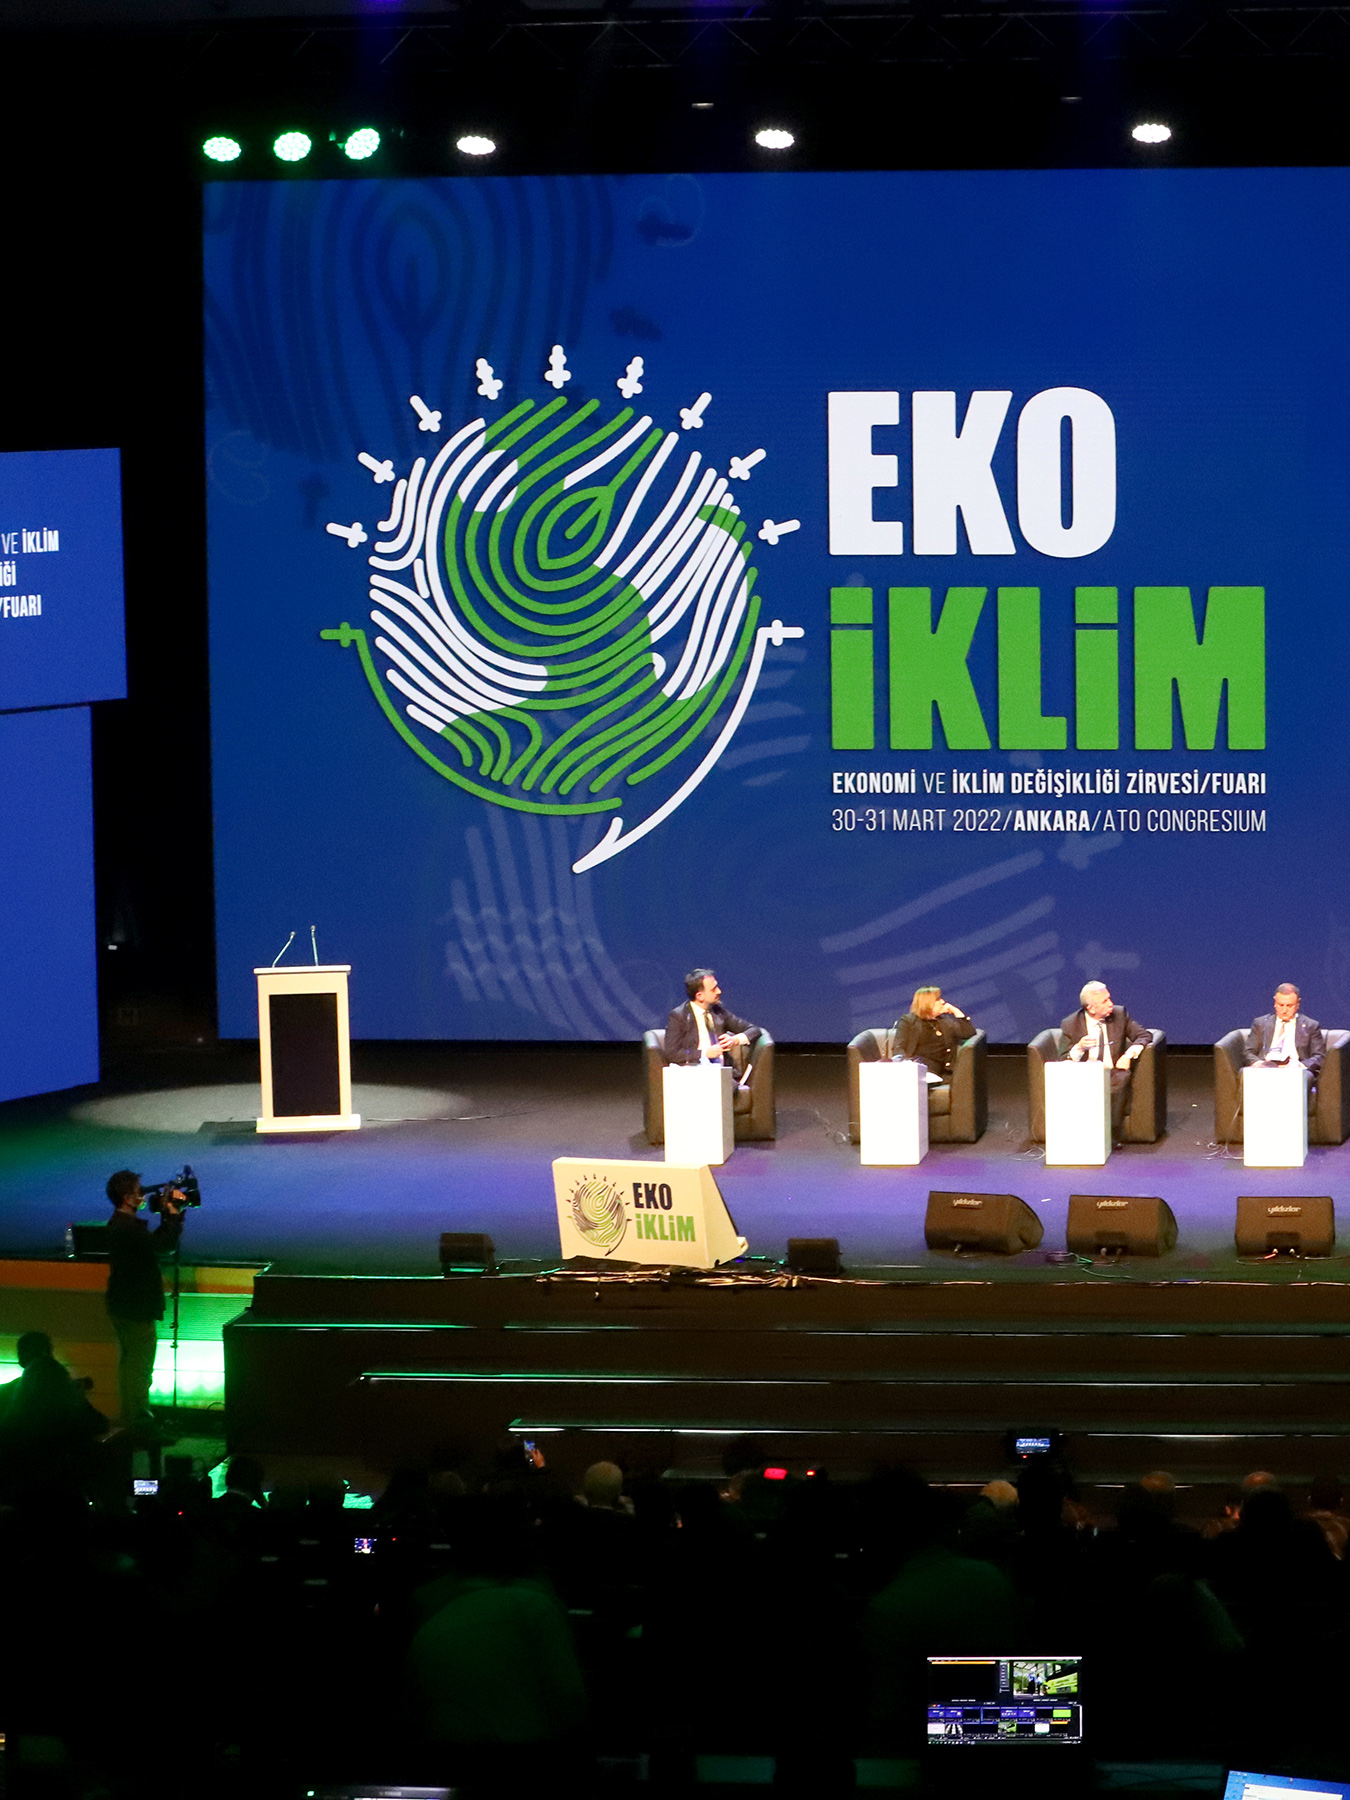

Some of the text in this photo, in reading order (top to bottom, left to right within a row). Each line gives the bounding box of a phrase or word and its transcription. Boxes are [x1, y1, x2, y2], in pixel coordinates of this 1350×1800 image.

[828, 386, 1117, 559] EKO
[1, 527, 59, 554] VE İKLİM
[832, 769, 916, 794] EKONOMİ
[922, 772, 946, 794] VE
[952, 769, 1004, 794] İKLİM
[1011, 769, 1120, 798] DEĞİŞİKLİĞİ
[832, 808, 886, 831] 30-31
[892, 808, 946, 831] MART
[1147, 809, 1267, 832] CONGRESIUM
[632, 1182, 673, 1210] EKO
